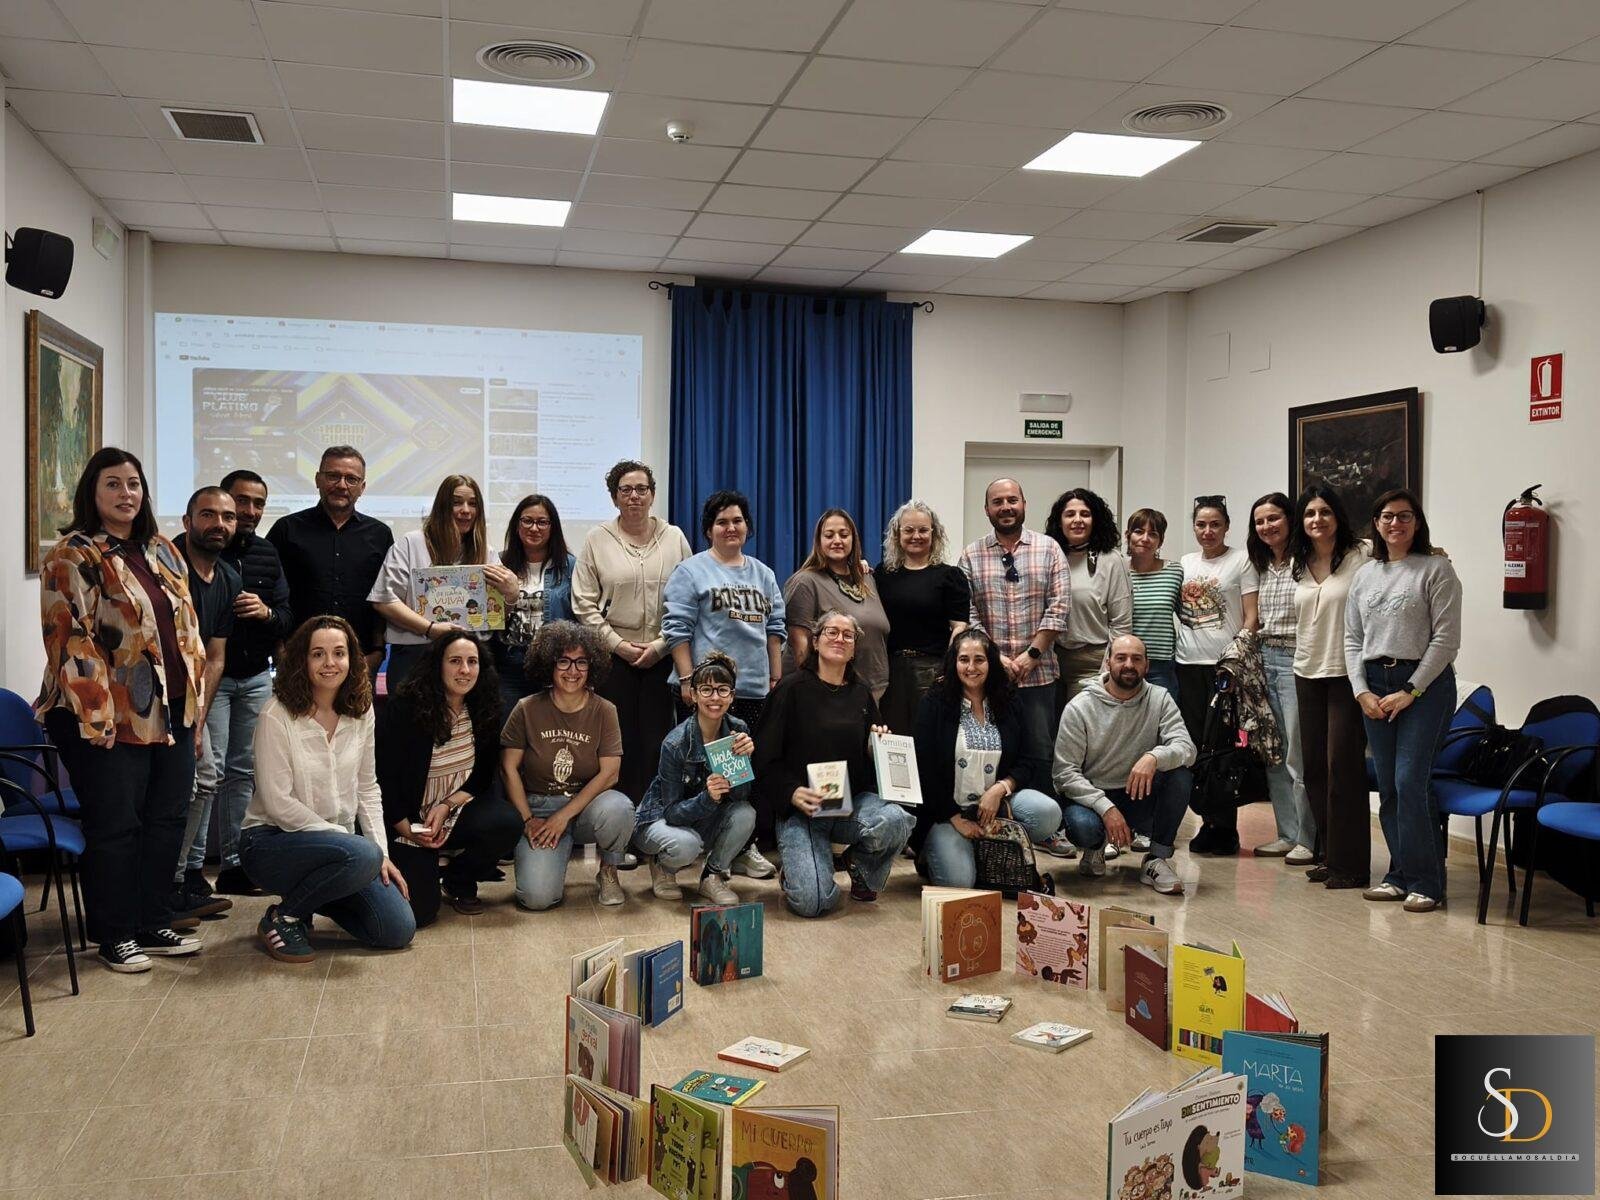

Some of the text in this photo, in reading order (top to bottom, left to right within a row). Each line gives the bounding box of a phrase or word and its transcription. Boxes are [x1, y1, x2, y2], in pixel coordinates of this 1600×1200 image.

[1531, 406, 1560, 417] EXTINTOR
[711, 586, 772, 617] BOSTON
[541, 729, 591, 743] MILKSHAKE
[1243, 1060, 1303, 1085] MARTA
[1122, 1131, 1132, 1146] Tu
[1133, 1127, 1152, 1142] cuerpo
